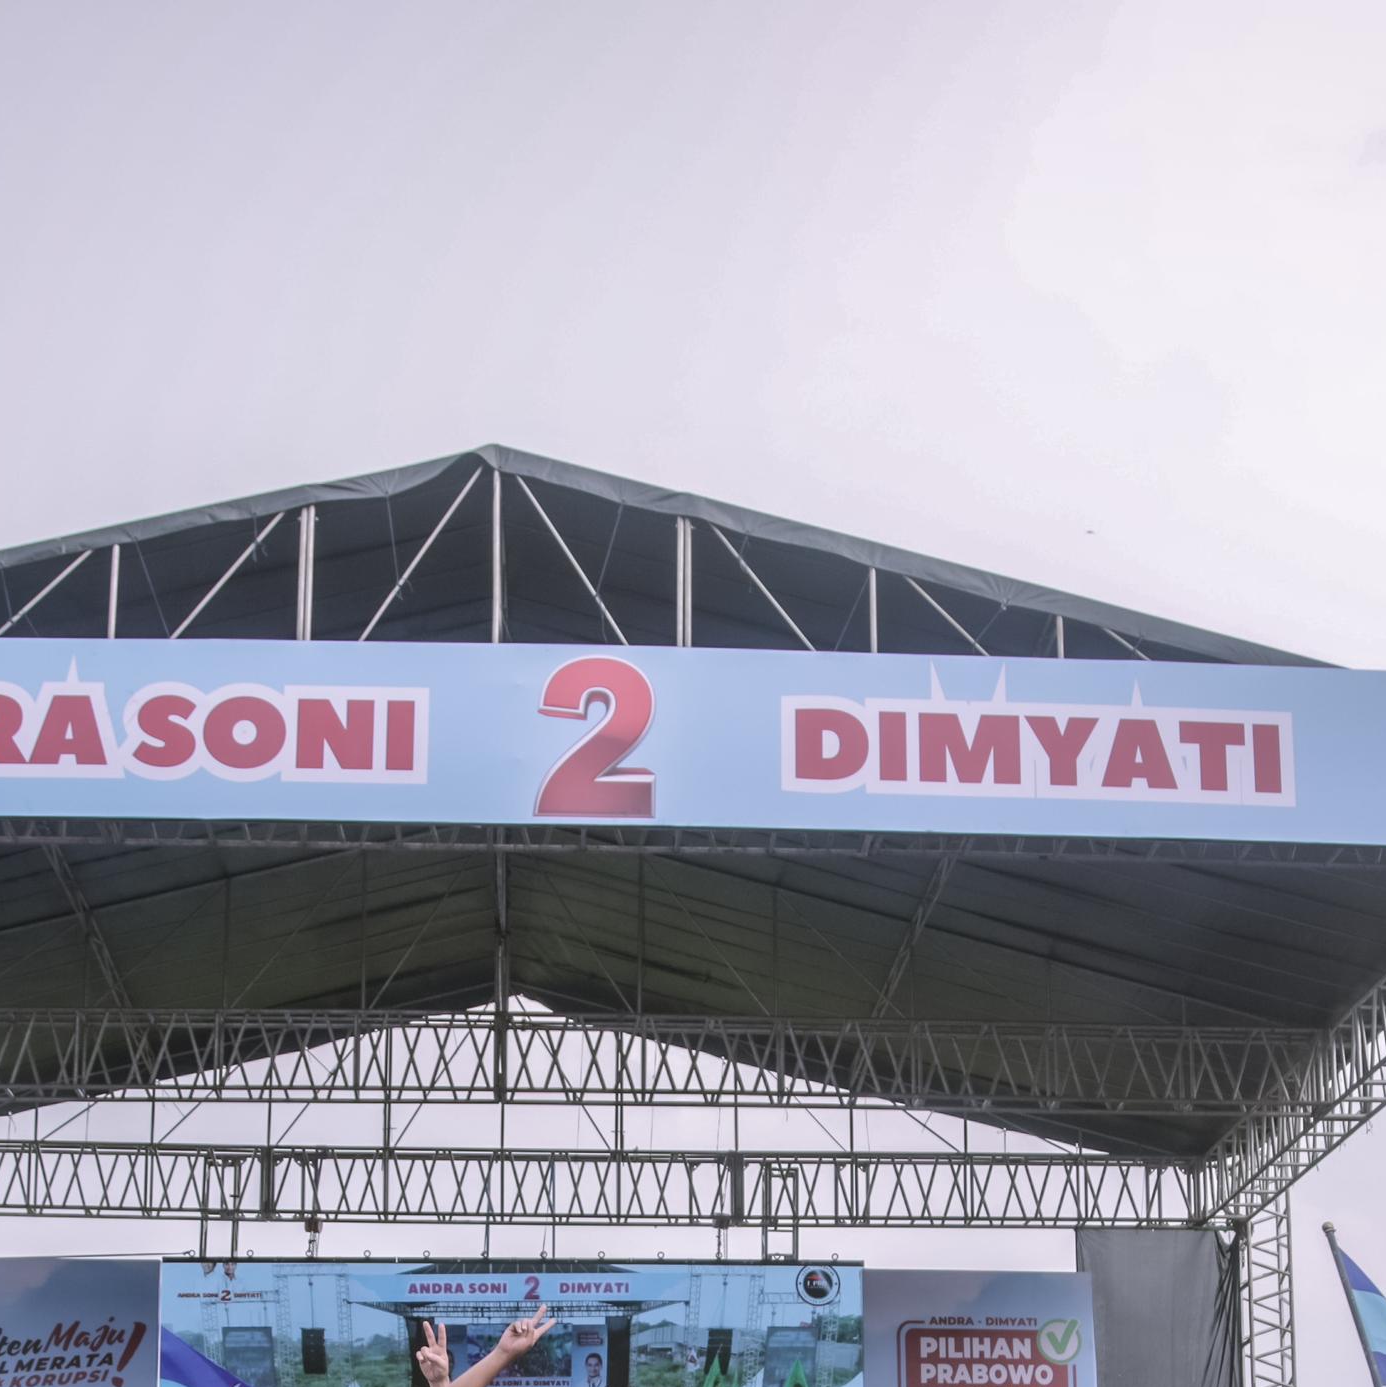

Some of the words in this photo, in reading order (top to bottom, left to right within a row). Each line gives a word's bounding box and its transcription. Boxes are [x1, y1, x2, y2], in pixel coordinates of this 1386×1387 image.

[132, 694, 417, 772] SONI
[533, 656, 655, 816] 2
[794, 707, 1283, 794] DIMYATI
[220, 1289, 231, 1302] 2
[408, 1282, 465, 1295] ANDRA
[468, 1282, 508, 1294] SONI
[523, 1275, 541, 1300] 2
[559, 1282, 630, 1294] DIMYATI
[929, 1316, 974, 1327] ANDRA
[985, 1317, 1038, 1327] DIMYATI
[920, 1336, 1032, 1360] PILIHAN
[13, 1352, 114, 1374] MERATA
[920, 1362, 1054, 1386] PRABOWO
